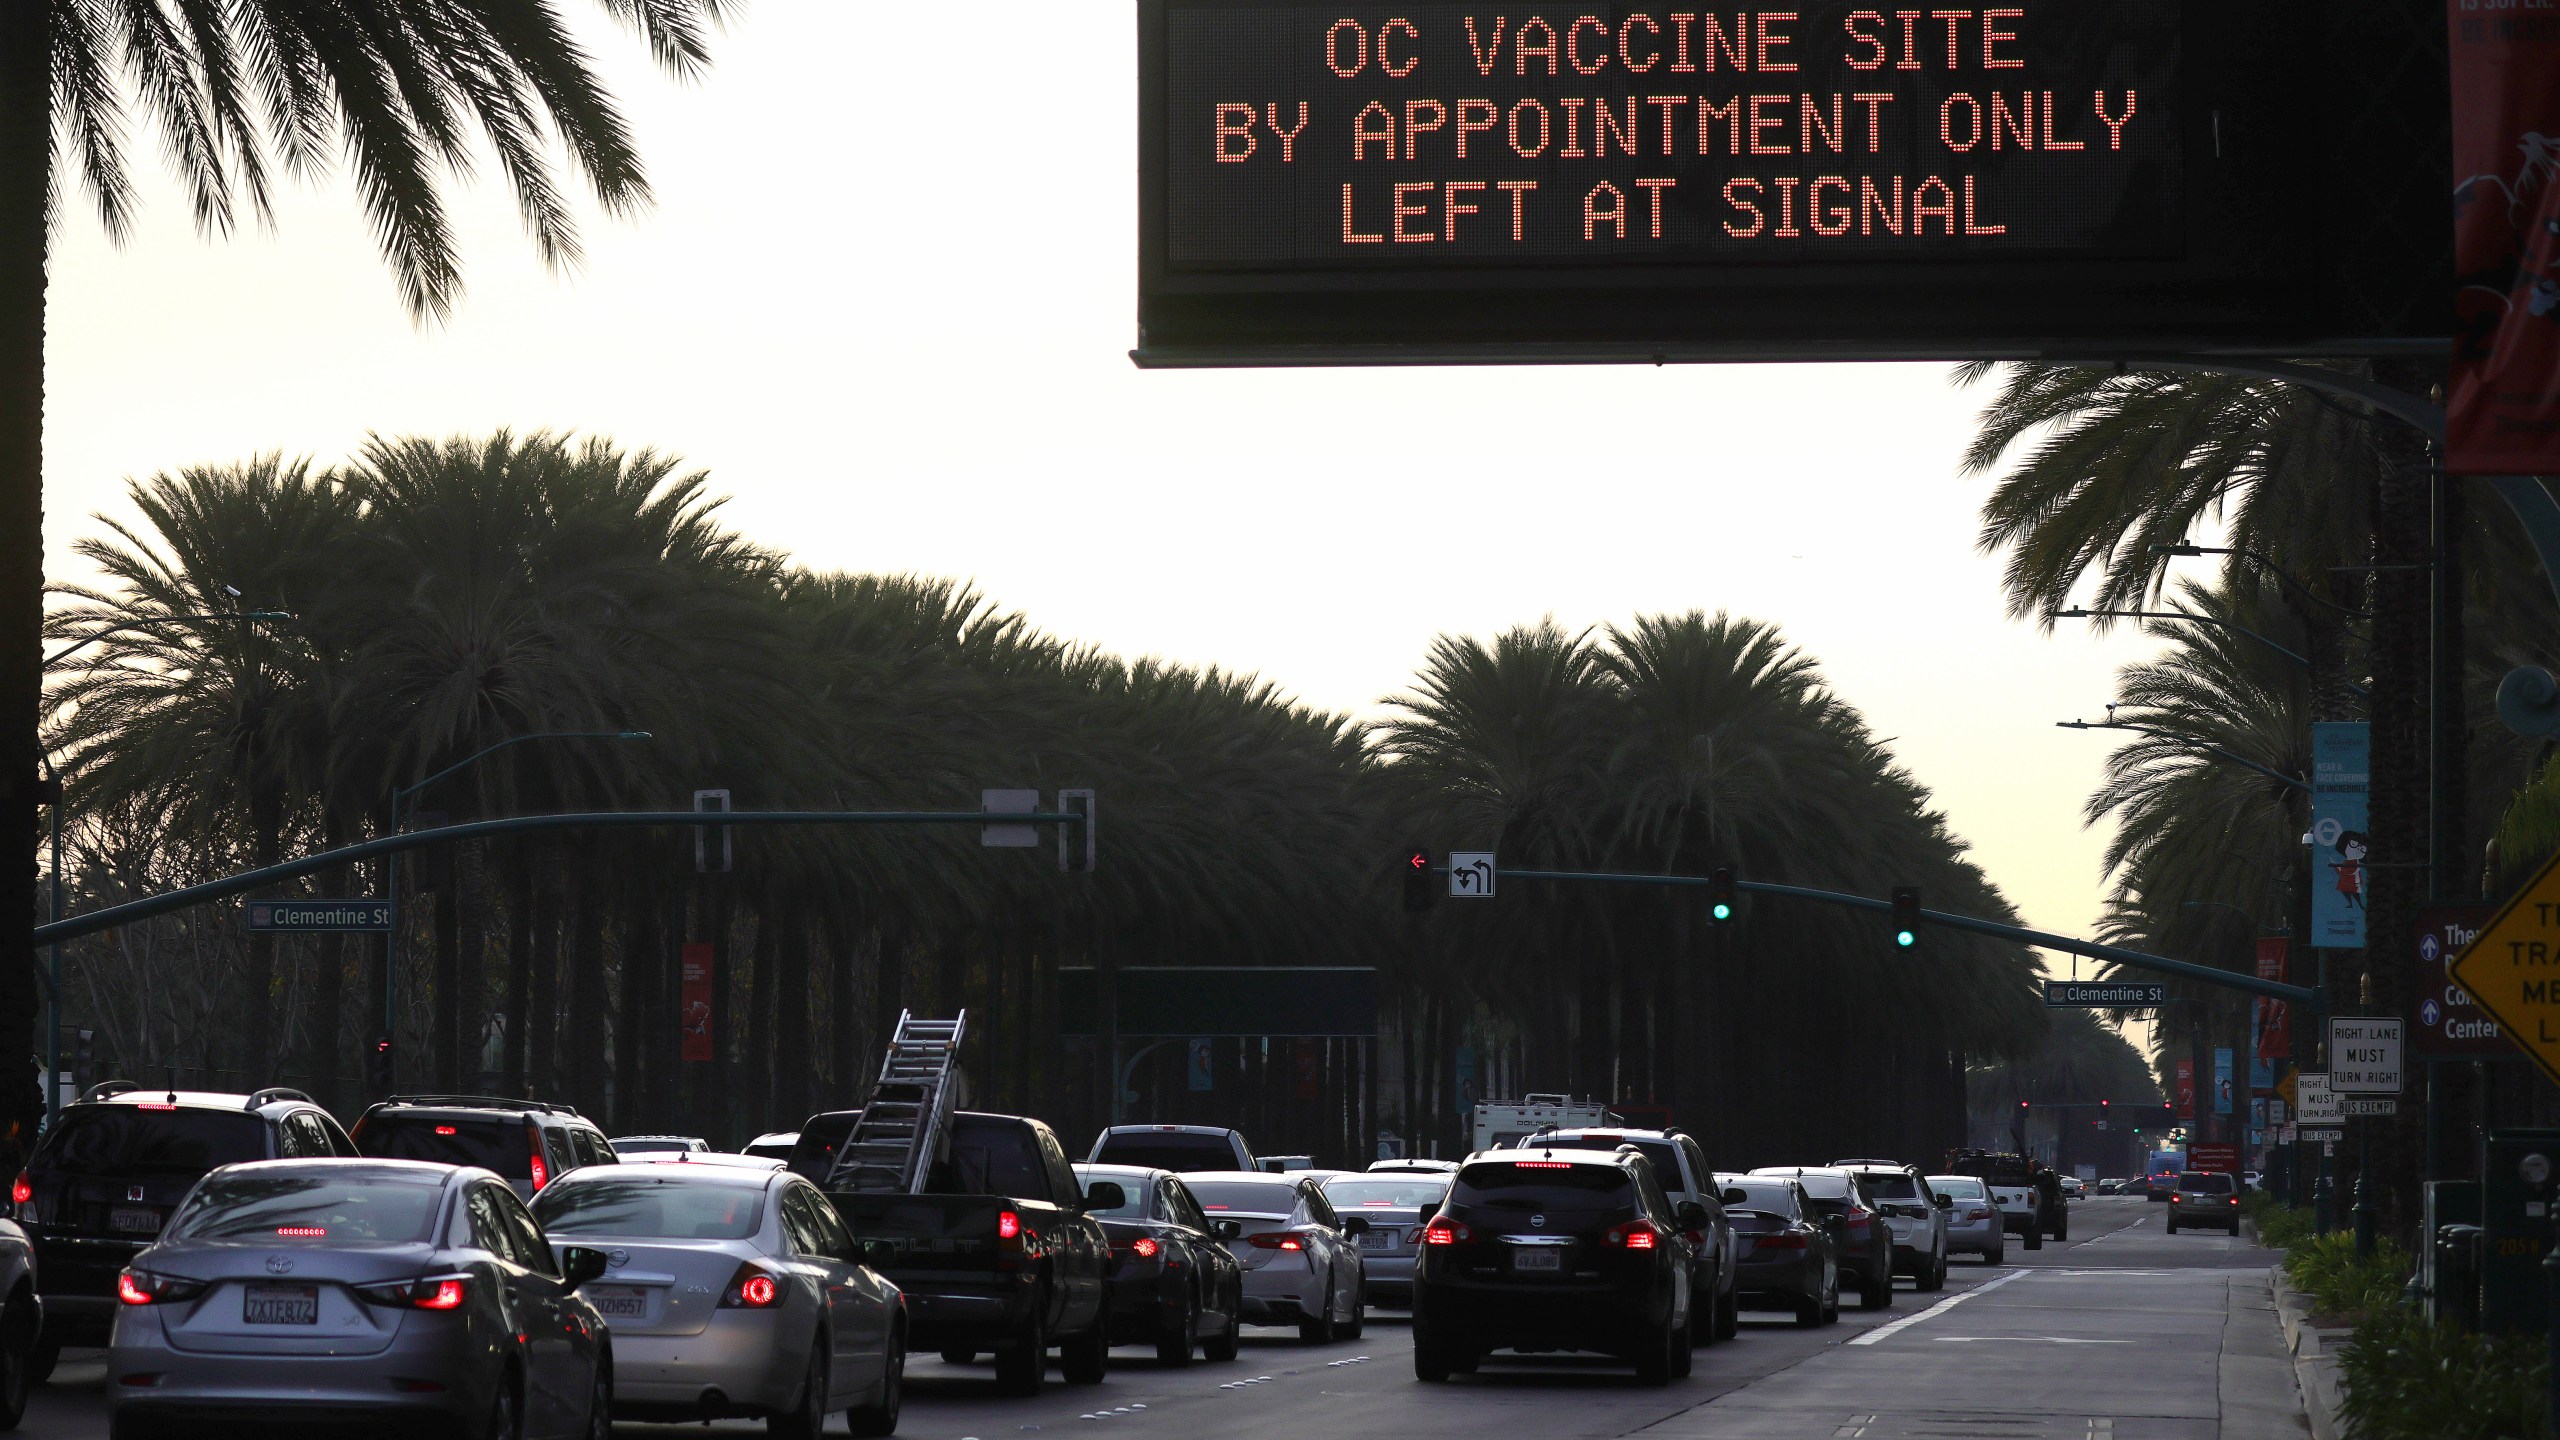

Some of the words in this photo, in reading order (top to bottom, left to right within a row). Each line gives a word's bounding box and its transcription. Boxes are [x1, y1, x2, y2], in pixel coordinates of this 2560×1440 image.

[1327, 18, 1418, 78] OC
[1465, 13, 1798, 75] VACCINE
[1845, 9, 2023, 69] SITE
[1217, 102, 1308, 162] BY
[1355, 93, 1893, 160] APPOINTMENT
[1941, 91, 2135, 151] ONLY
[1343, 181, 1537, 243] LEFT
[1584, 179, 1676, 240] AT
[1723, 176, 2005, 237] SIGNAL
[2316, 762, 2336, 771] WEAR
[2316, 773, 2334, 782] FACE
[274, 907, 366, 925] Clementine
[373, 908, 389, 925] St
[2445, 924, 2480, 945] The
[2067, 986, 2144, 1001] Clementine
[2149, 987, 2162, 1001] St
[2335, 1028, 2363, 1039] RIGHT
[2370, 1028, 2398, 1039] LANE
[2445, 1018, 2498, 1039] Center
[2346, 1049, 2385, 1062] MUST
[2334, 1071, 2361, 1083] TURN
[2368, 1072, 2398, 1083] RIGHT
[2300, 1080, 2321, 1089] RIGHT
[2309, 1094, 2335, 1104] MUST
[2339, 1101, 2356, 1113] BUS
[2360, 1101, 2393, 1113] EXEMPT
[2299, 1109, 2319, 1118] TURN
[2303, 1131, 2316, 1140] BUS
[2317, 1131, 2340, 1140] EXEMPT
[249, 1299, 312, 1318] 7XTF872
